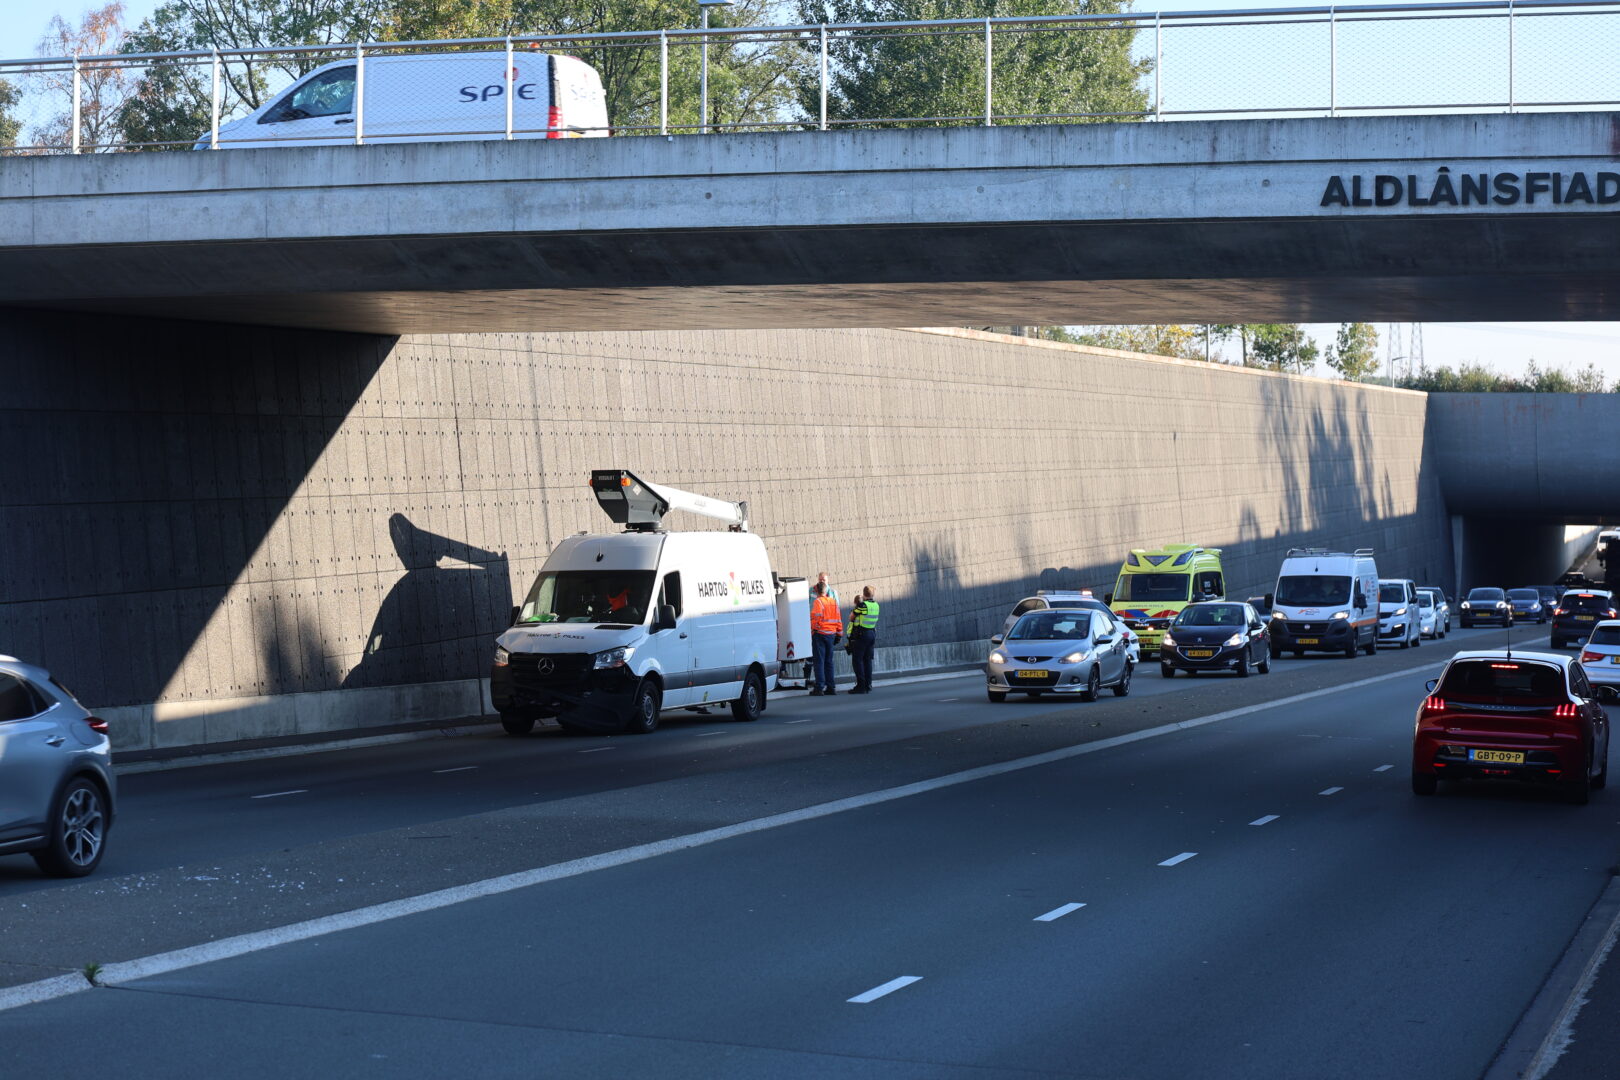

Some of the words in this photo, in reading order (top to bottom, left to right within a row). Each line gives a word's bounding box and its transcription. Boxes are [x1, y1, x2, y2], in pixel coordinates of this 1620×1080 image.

[458, 82, 537, 103] SPE
[1320, 166, 1620, 207] ALDLÂNSFIAD
[697, 581, 728, 598] HARTOG
[740, 579, 765, 596] PILKES
[1477, 751, 1521, 762] GBT-09-P
